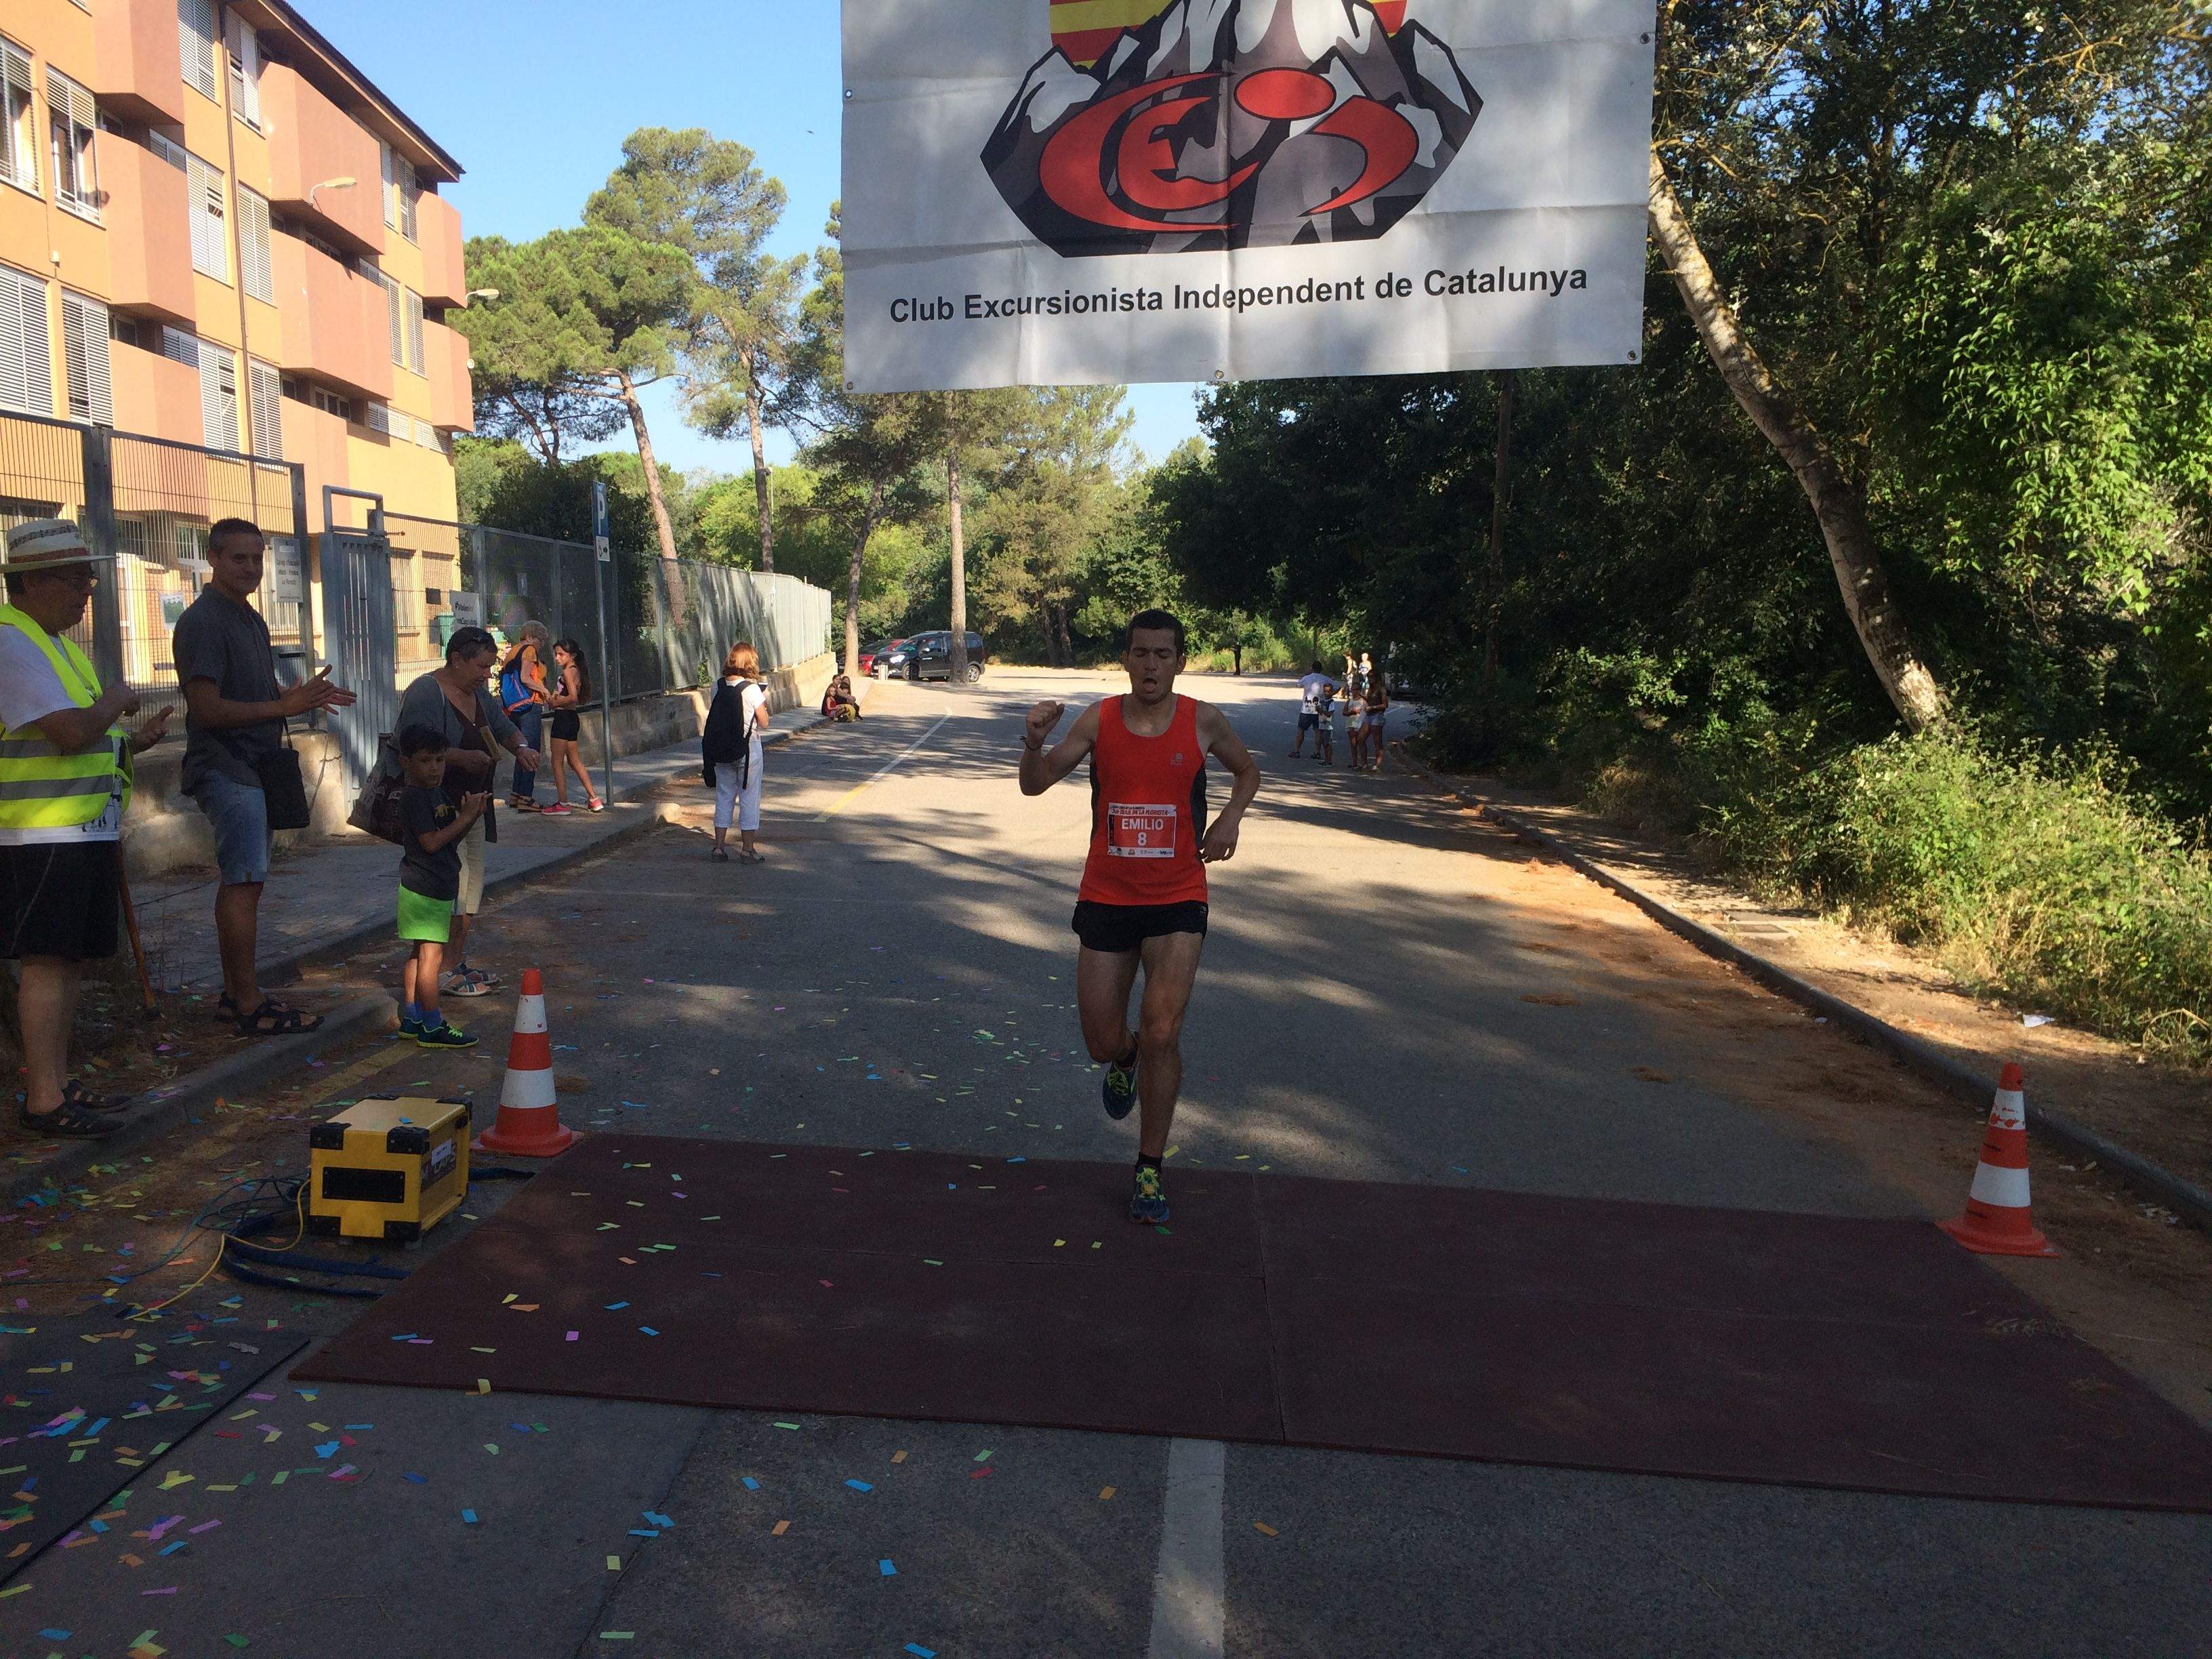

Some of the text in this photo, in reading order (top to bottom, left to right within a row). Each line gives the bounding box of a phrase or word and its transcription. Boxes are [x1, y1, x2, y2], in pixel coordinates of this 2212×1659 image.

[890, 266, 1586, 323] Club Excursionista Independent de Catalunya
[597, 492, 605, 535] P
[1122, 818, 1164, 830] EMILIO
[1137, 832, 1147, 846] 8
